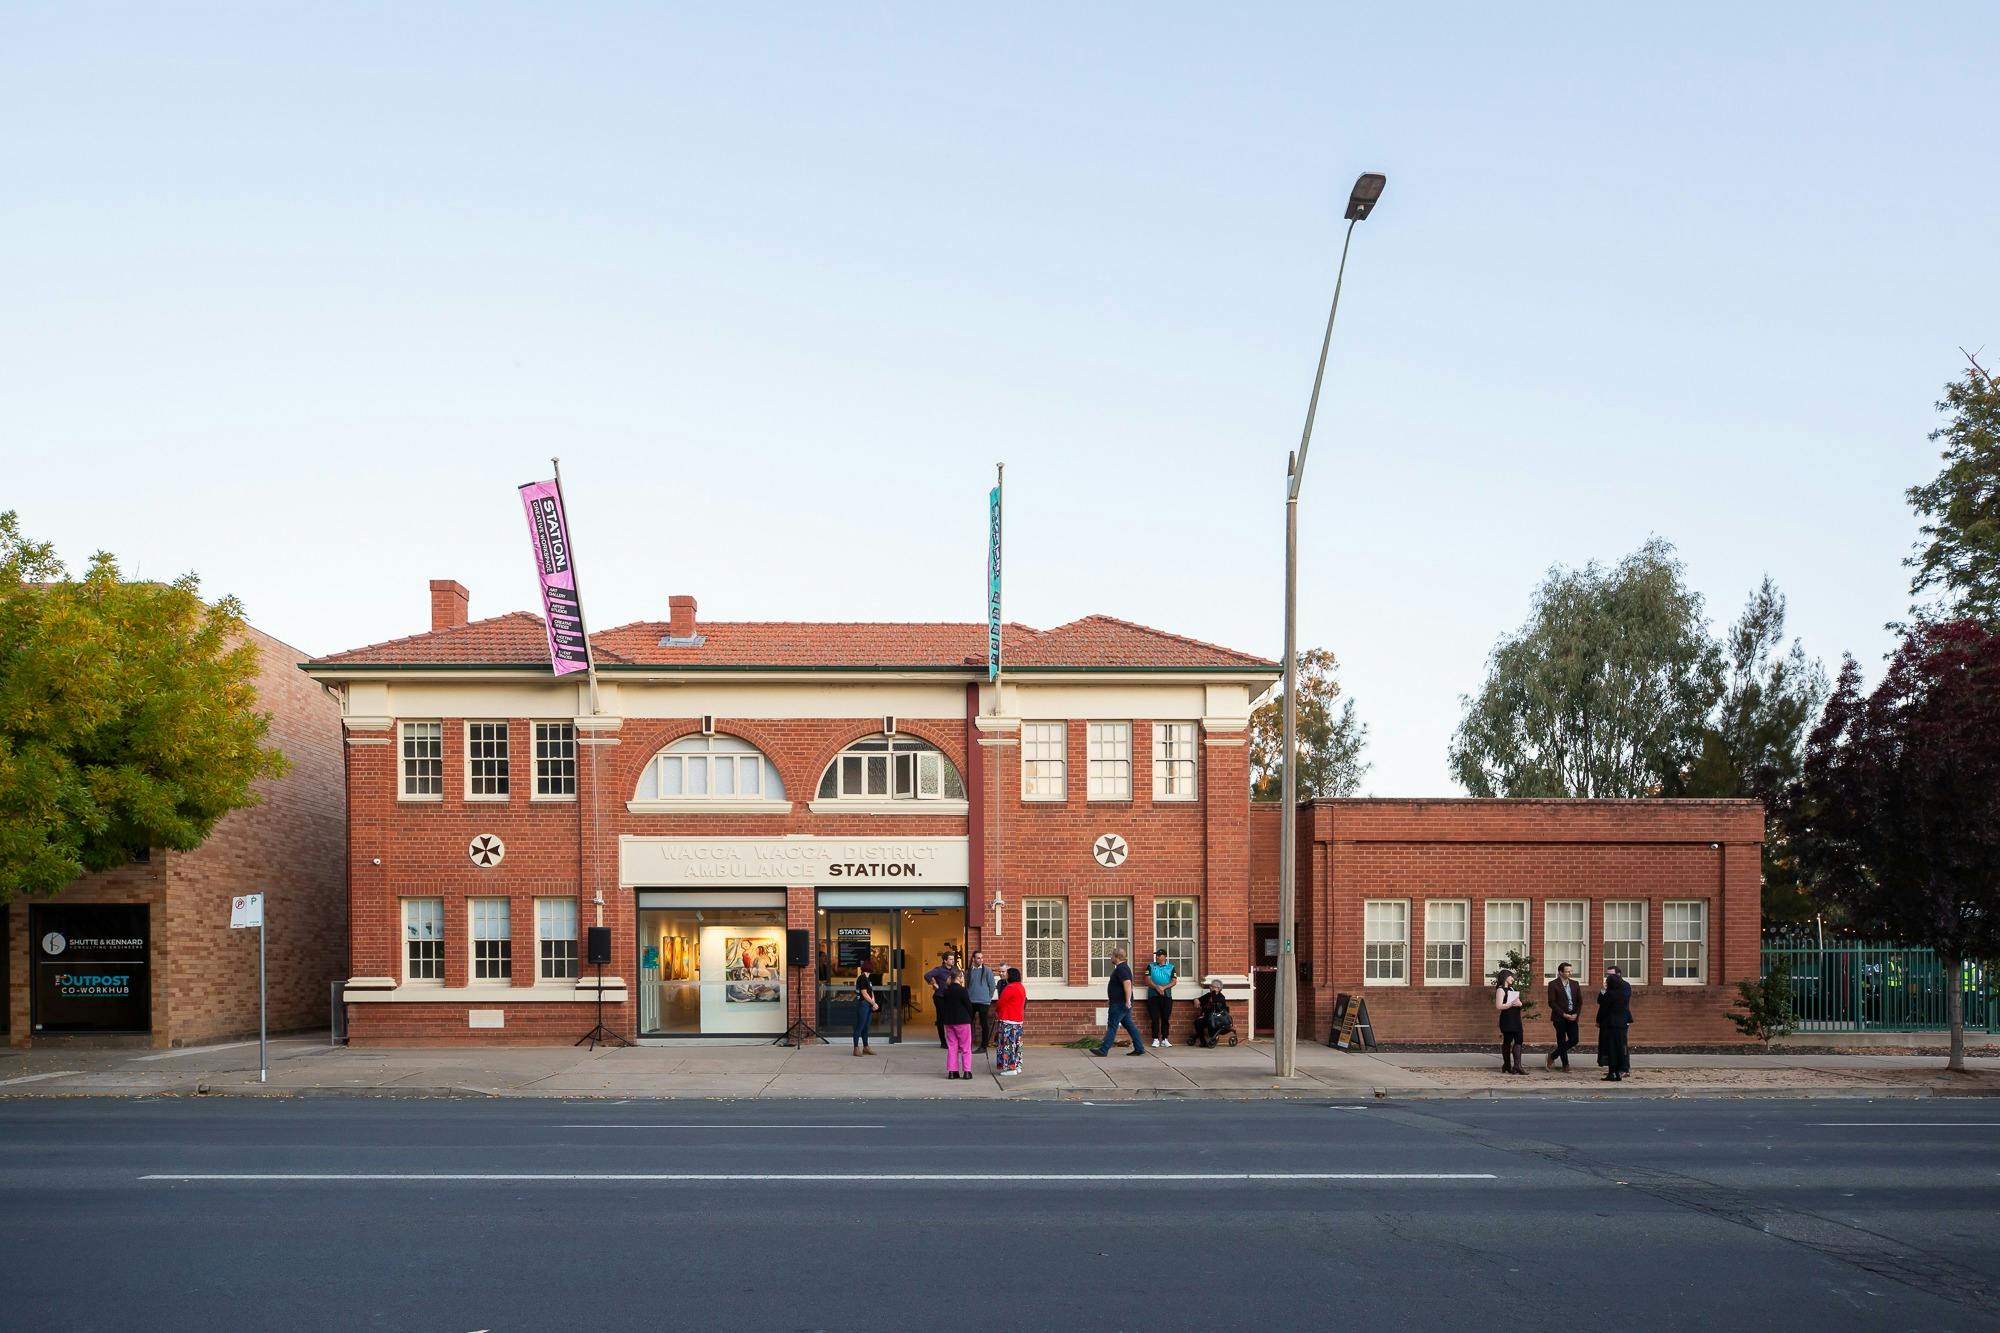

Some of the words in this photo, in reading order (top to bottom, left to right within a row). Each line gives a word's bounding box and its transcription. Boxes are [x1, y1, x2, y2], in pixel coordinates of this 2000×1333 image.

[532, 501, 543, 533] CREATIVE
[540, 533, 553, 573] WORKSPACE
[543, 500, 567, 571] STATION.
[661, 846, 741, 860] WAGGA
[754, 846, 832, 860] WAGGA
[844, 846, 938, 860] DISTRICT
[684, 863, 815, 878] AMBULANCE
[828, 863, 923, 877] STATION.
[61, 974, 130, 986] OUTPOST
